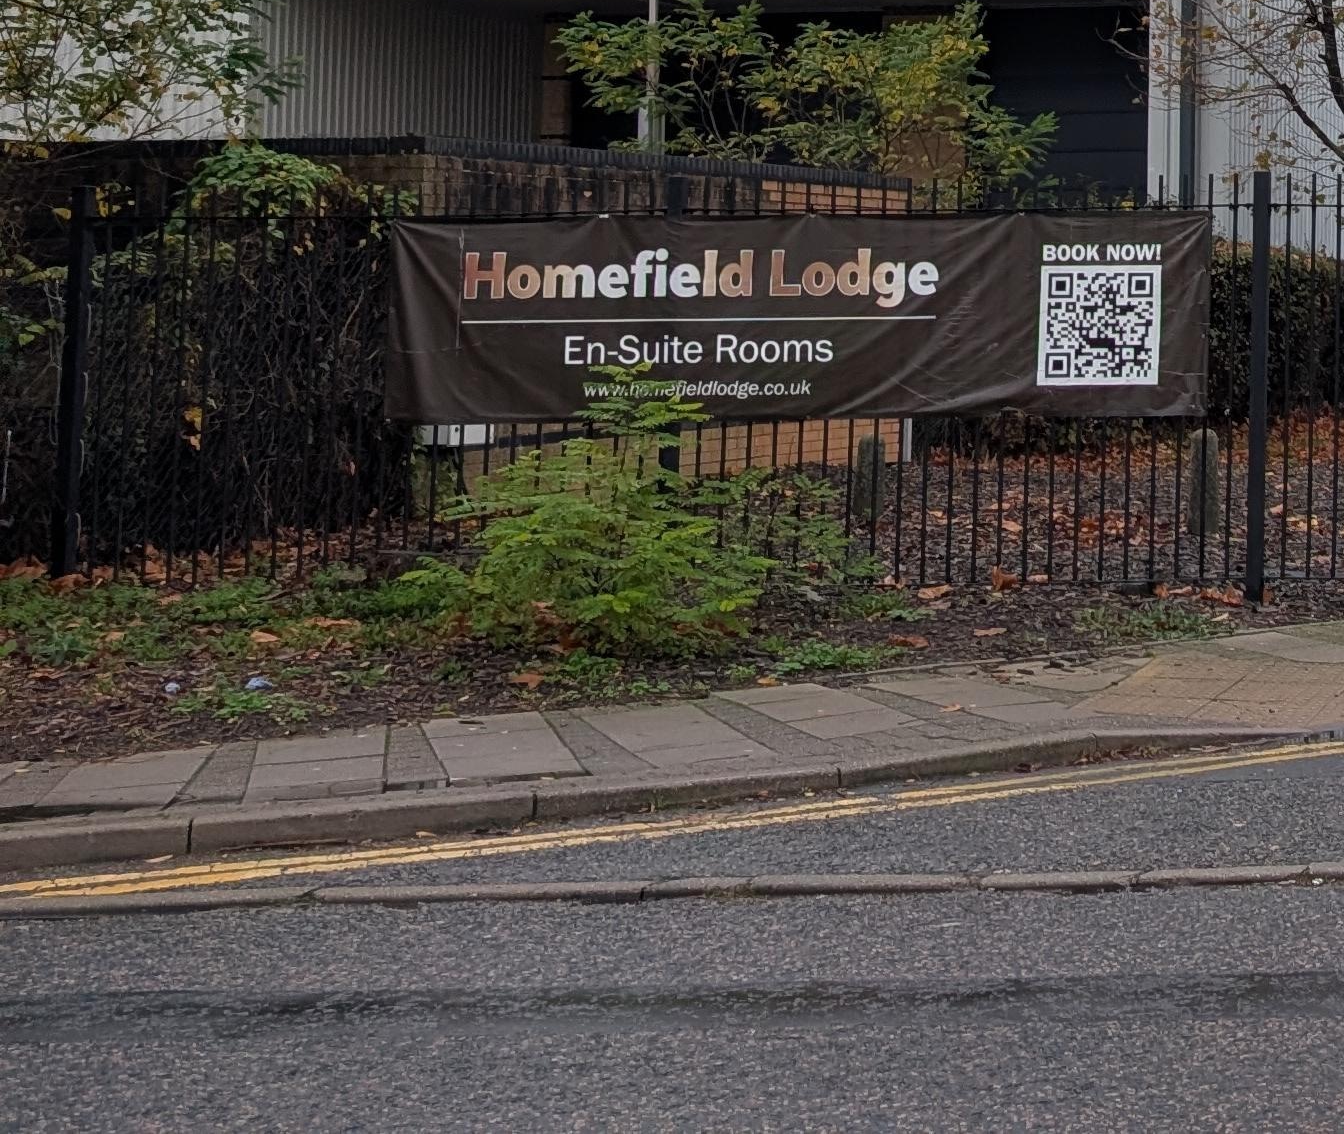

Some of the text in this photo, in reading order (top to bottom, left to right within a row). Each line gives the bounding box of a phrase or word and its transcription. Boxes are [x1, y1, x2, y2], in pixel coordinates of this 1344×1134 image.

[1042, 243, 1162, 262] BOOK NOW!
[463, 247, 940, 308] Homefield Lodge
[563, 334, 834, 366] En-Suite Rooms
